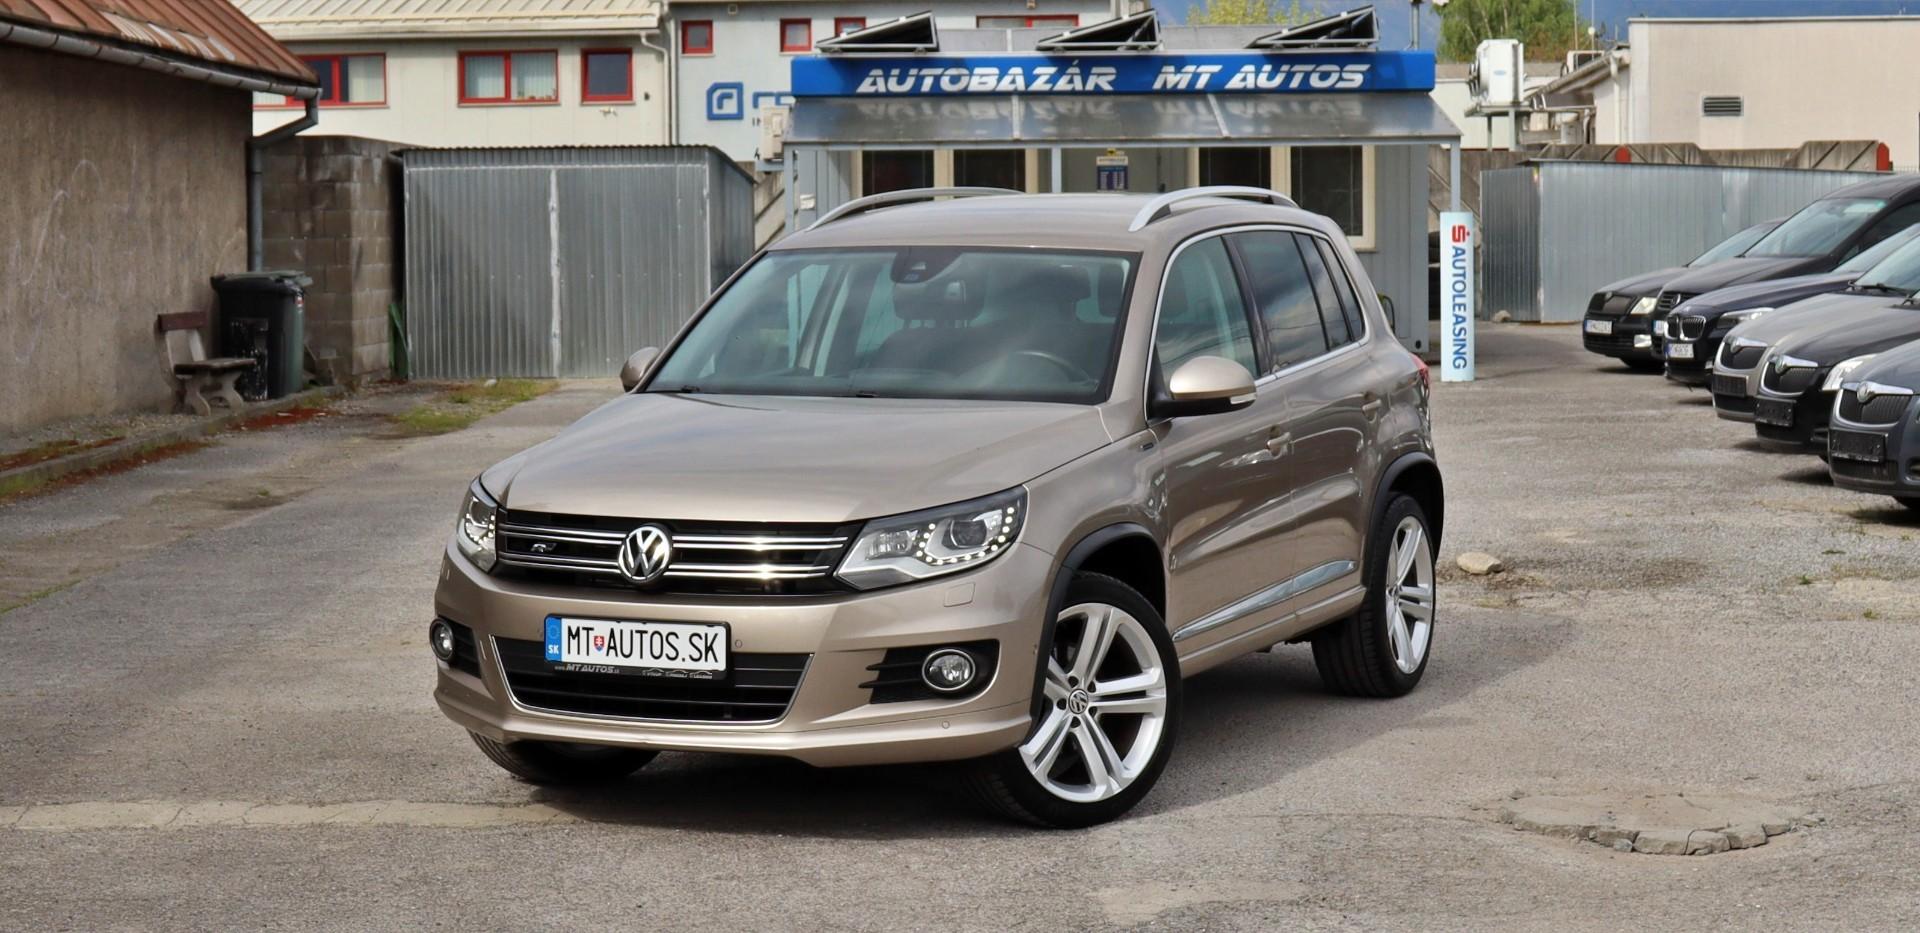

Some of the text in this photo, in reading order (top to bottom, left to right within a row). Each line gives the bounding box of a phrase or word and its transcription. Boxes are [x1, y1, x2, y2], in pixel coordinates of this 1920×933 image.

[856, 59, 1371, 93] AUTOBAZÁR MT AUTOS
[1452, 245, 1467, 370] AUTOLEASING
[548, 644, 559, 654] SK
[567, 625, 719, 663] MT AUTOS.SK
